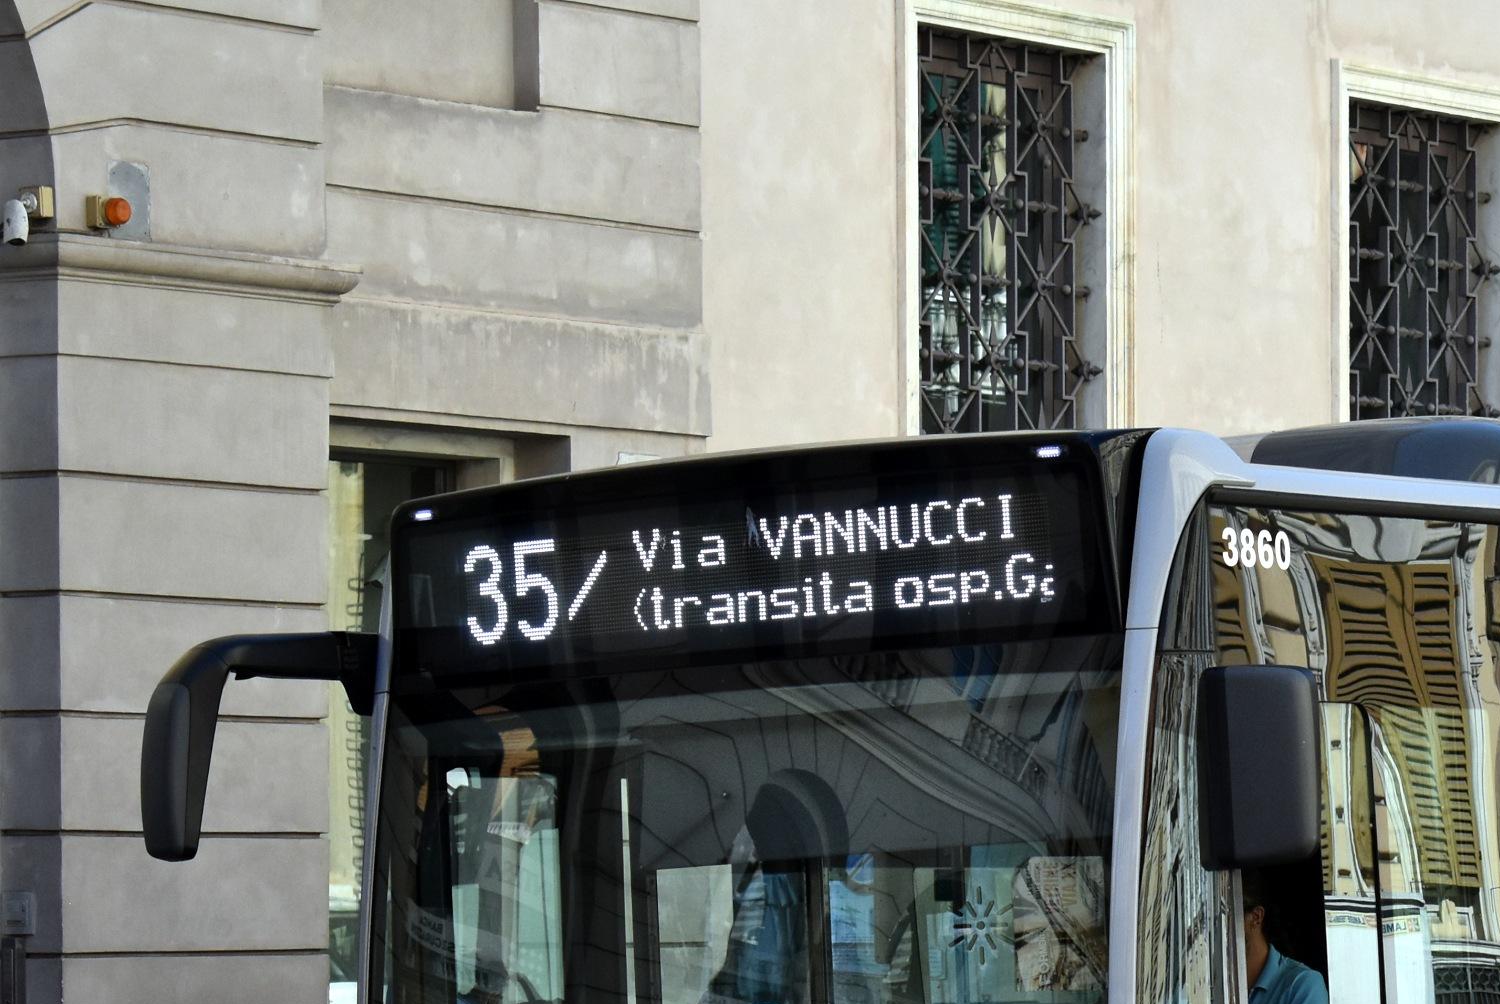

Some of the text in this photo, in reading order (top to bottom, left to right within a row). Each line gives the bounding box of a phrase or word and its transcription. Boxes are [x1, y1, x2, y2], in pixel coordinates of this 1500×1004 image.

[632, 494, 1012, 572] Via VANNUCCI
[1221, 526, 1291, 571] 3860
